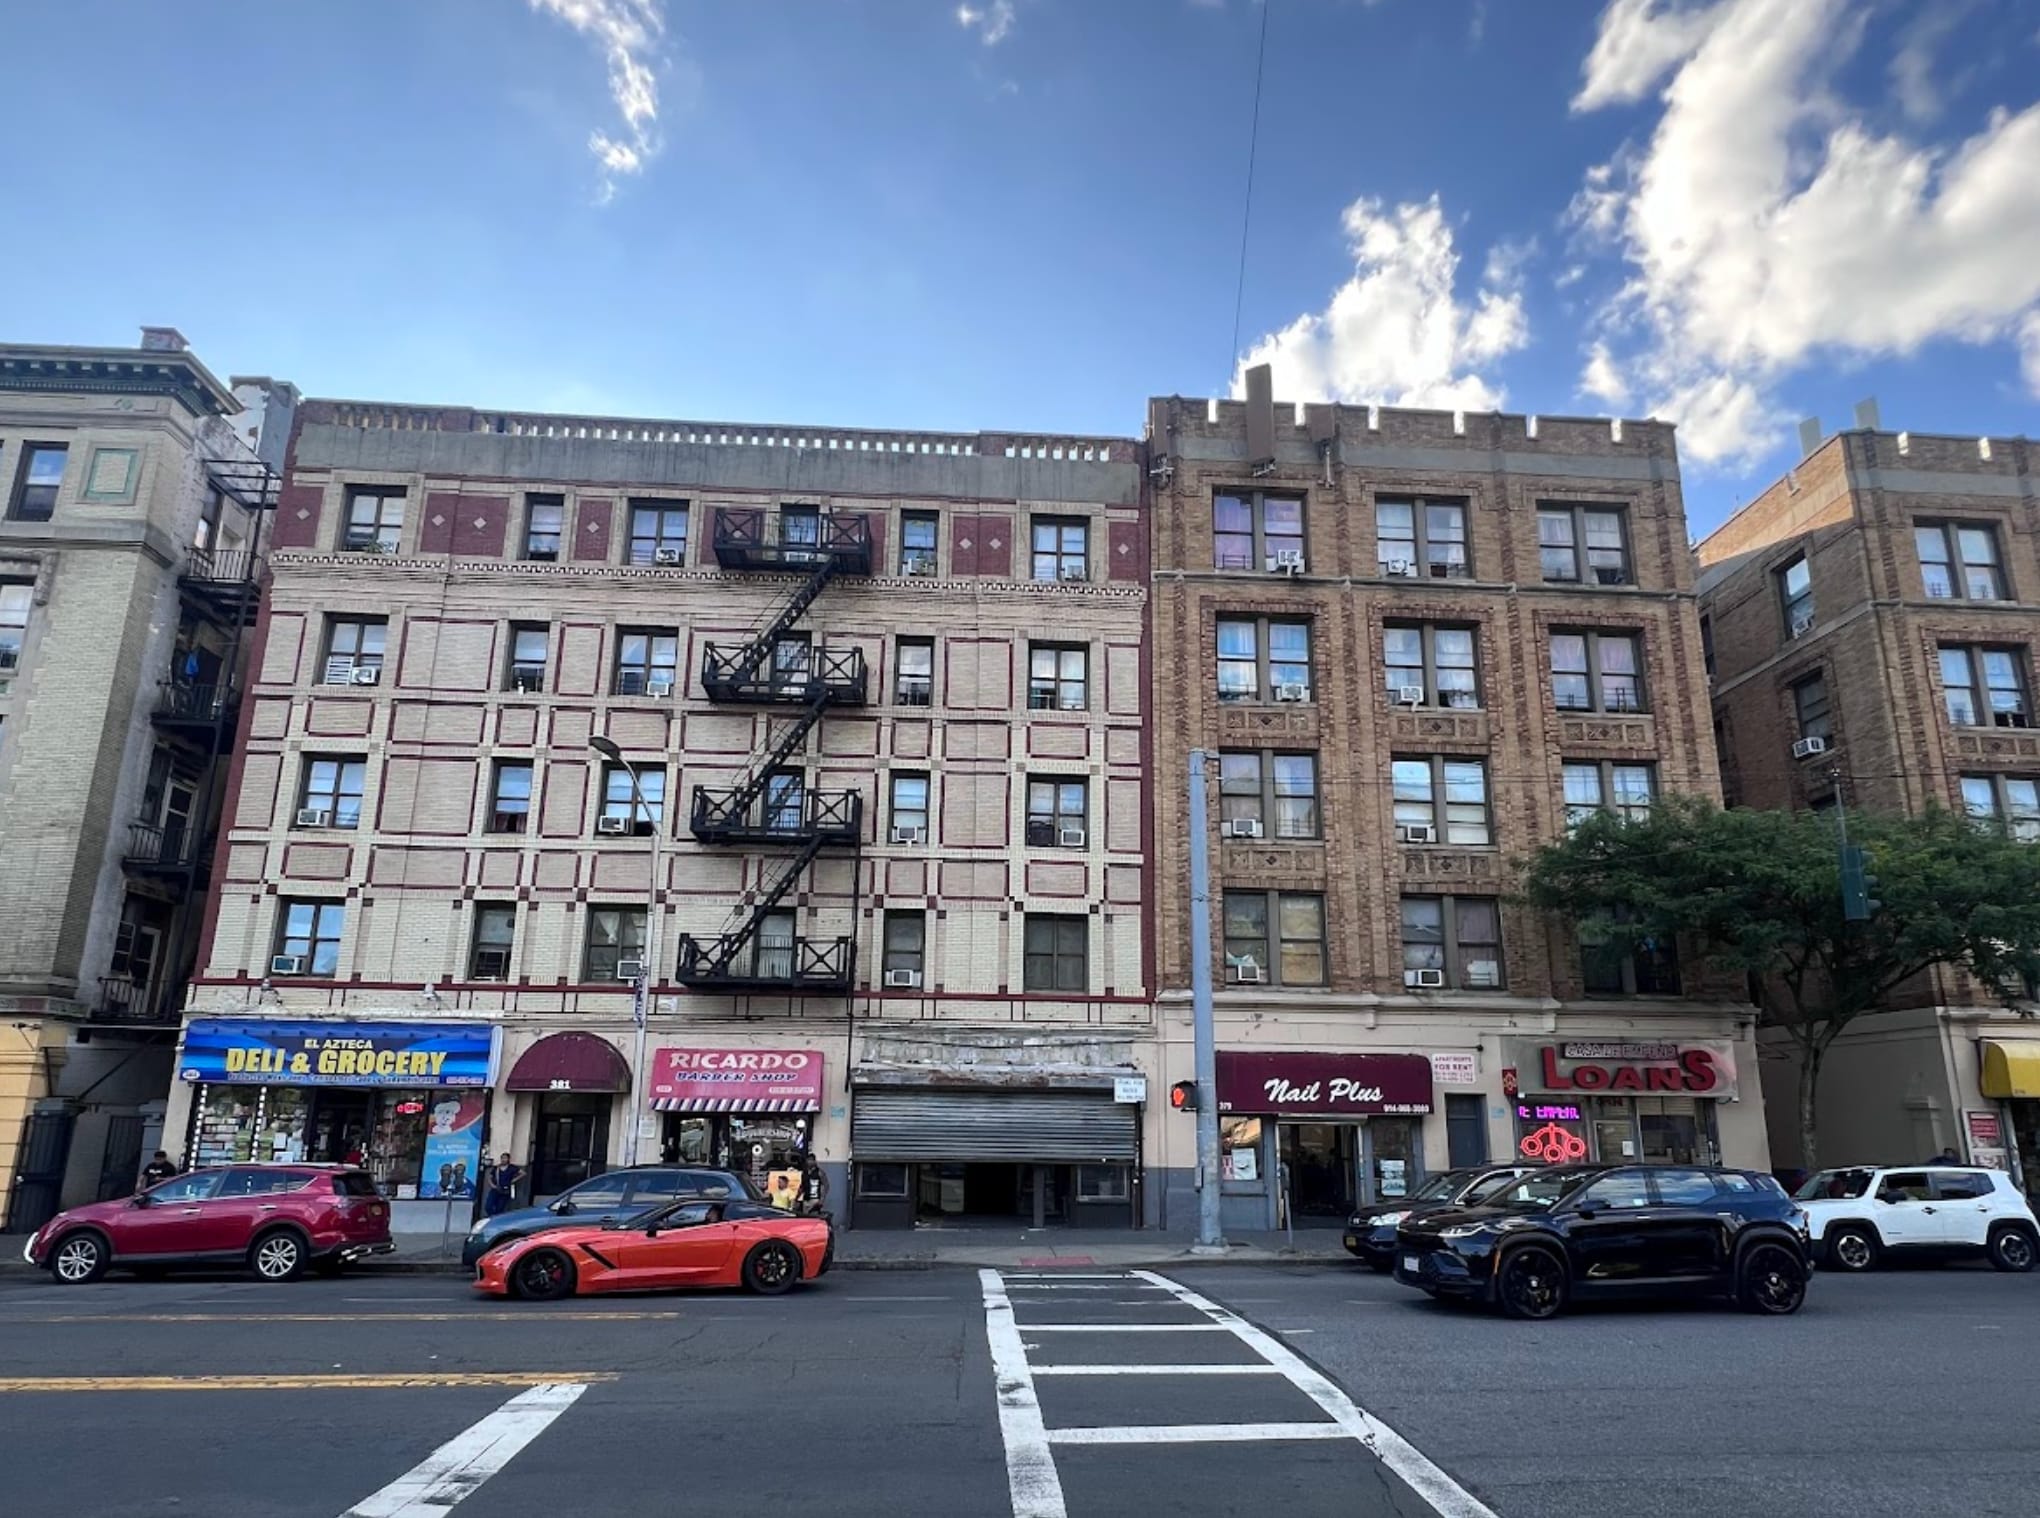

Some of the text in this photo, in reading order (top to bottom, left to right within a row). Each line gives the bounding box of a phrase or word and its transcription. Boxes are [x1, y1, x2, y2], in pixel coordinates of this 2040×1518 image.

[304, 1039, 374, 1049] EL AZTECA
[226, 1048, 447, 1076] DELI & GROCERY
[669, 1053, 808, 1069] RICARDO
[1541, 1046, 1717, 1092] LOANS
[675, 1071, 798, 1083] BARBER SHOP
[1264, 1078, 1384, 1103] Nail Plus
